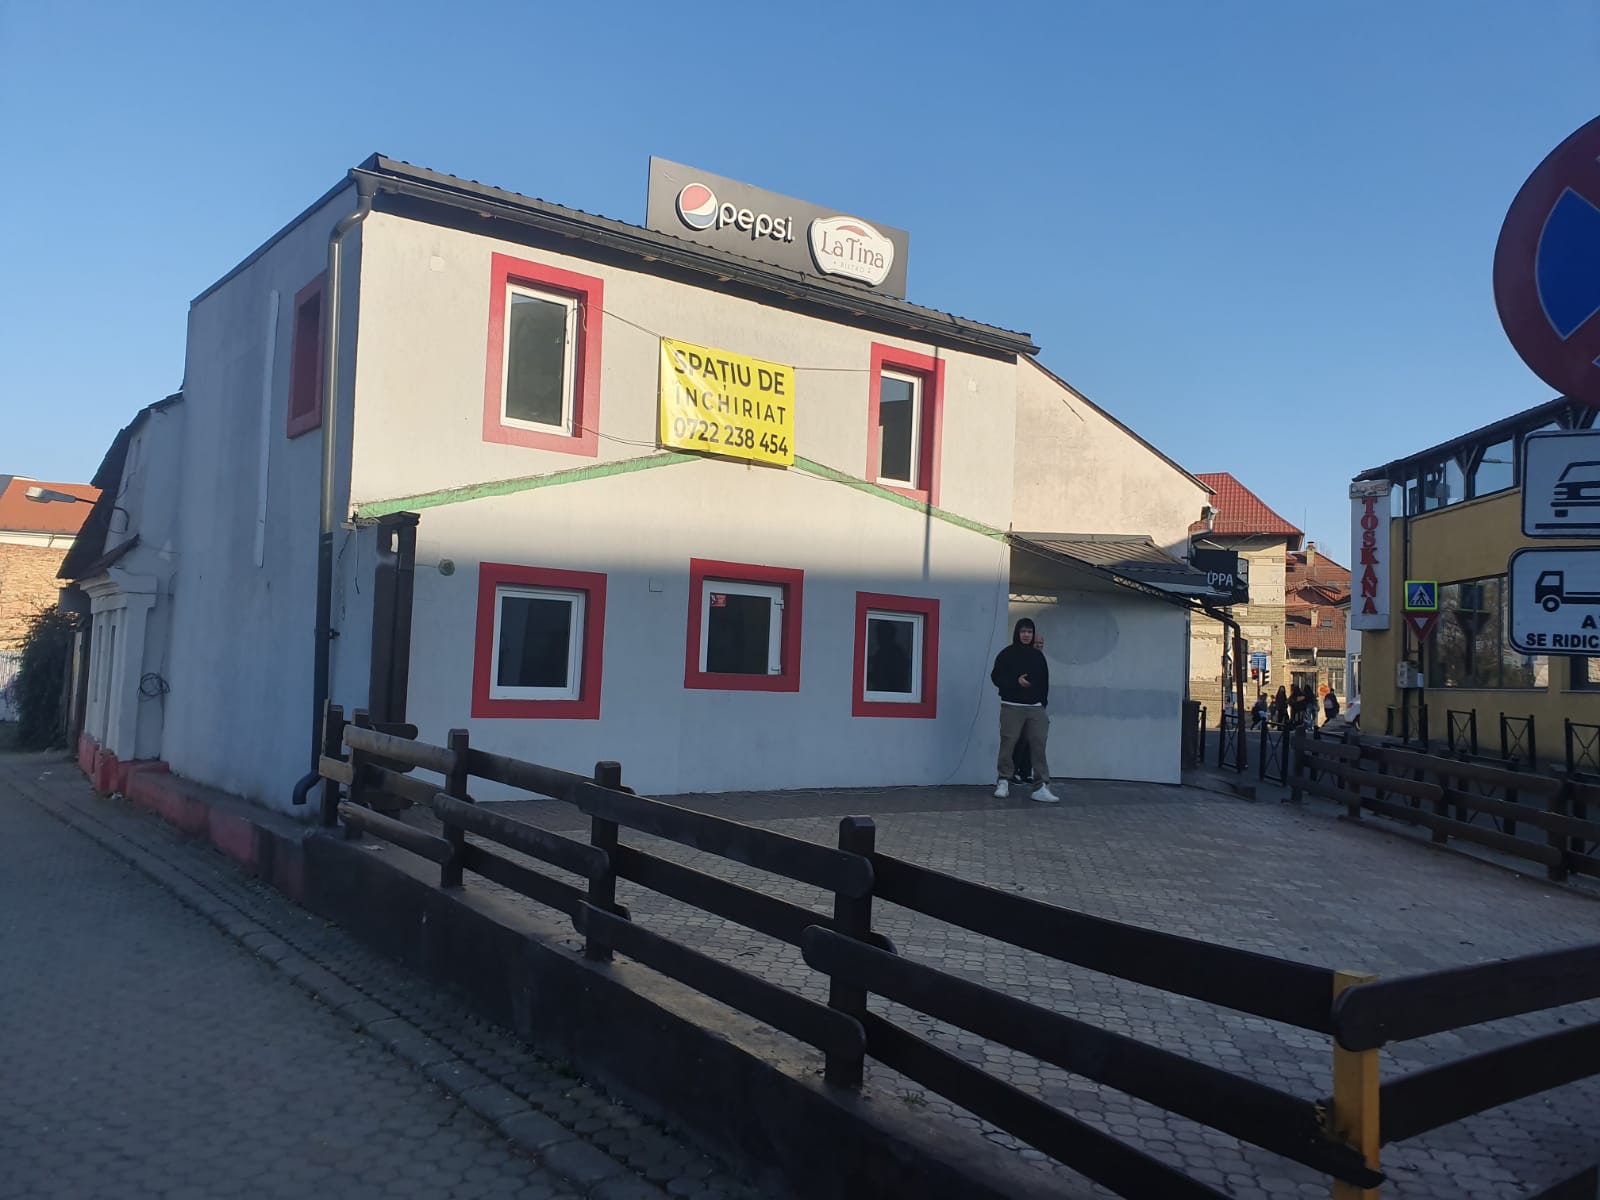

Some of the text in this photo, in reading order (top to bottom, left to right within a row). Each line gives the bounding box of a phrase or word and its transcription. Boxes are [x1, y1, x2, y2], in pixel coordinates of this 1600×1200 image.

[717, 202, 793, 241] pepsi
[821, 231, 884, 269] La Tina
[758, 368, 785, 396] DE
[673, 417, 789, 457] 0722 238 454
[1360, 496, 1380, 615] TOSKANA
[1526, 632, 1547, 647] SE
[1581, 614, 1600, 629] A
